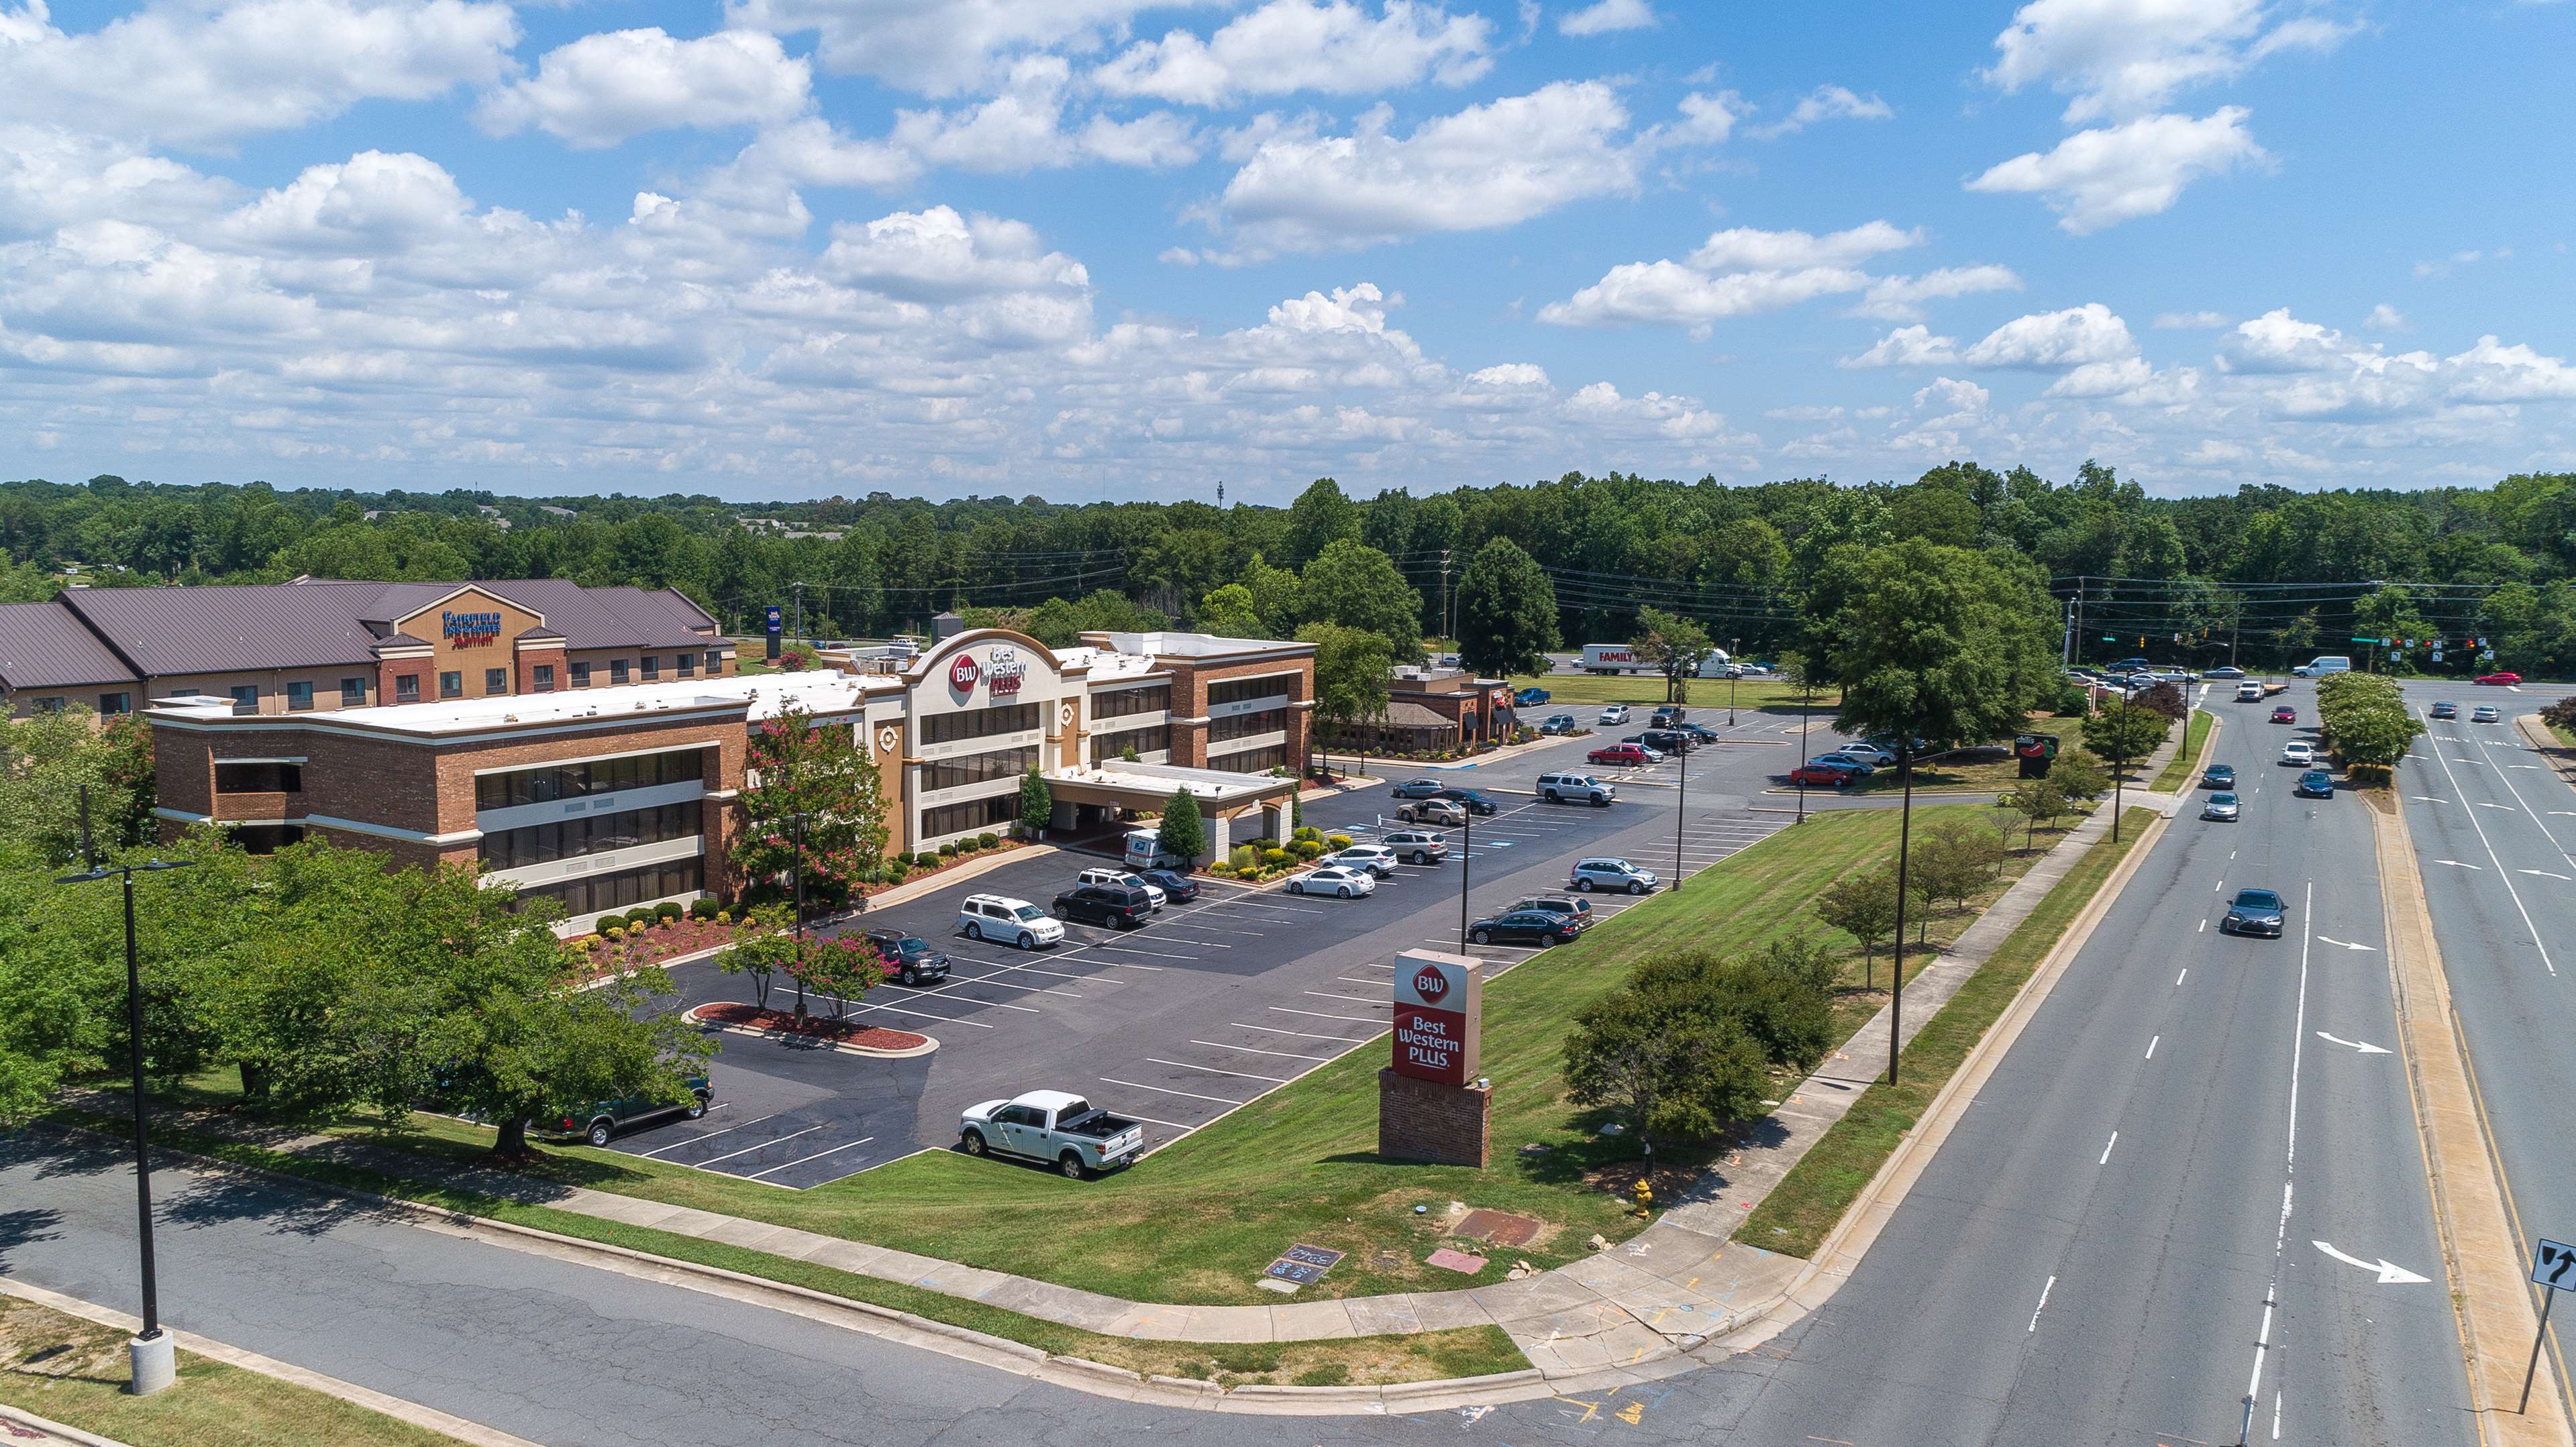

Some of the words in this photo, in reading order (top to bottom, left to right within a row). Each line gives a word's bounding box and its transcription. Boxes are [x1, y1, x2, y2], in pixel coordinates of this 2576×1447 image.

[443, 610, 501, 623] FAIRFIELD
[444, 625, 462, 634] INN
[464, 625, 471, 633] &
[472, 624, 501, 632] SUITES
[1599, 652, 1633, 662] FAMILY
[956, 666, 976, 682] BW
[982, 661, 1027, 676] Western
[992, 676, 1021, 691] PLUS
[1418, 975, 1443, 993] BW
[1413, 1016, 1446, 1035] Best
[1398, 1028, 1459, 1053] Western
[1409, 1047, 1448, 1067] PLUS
